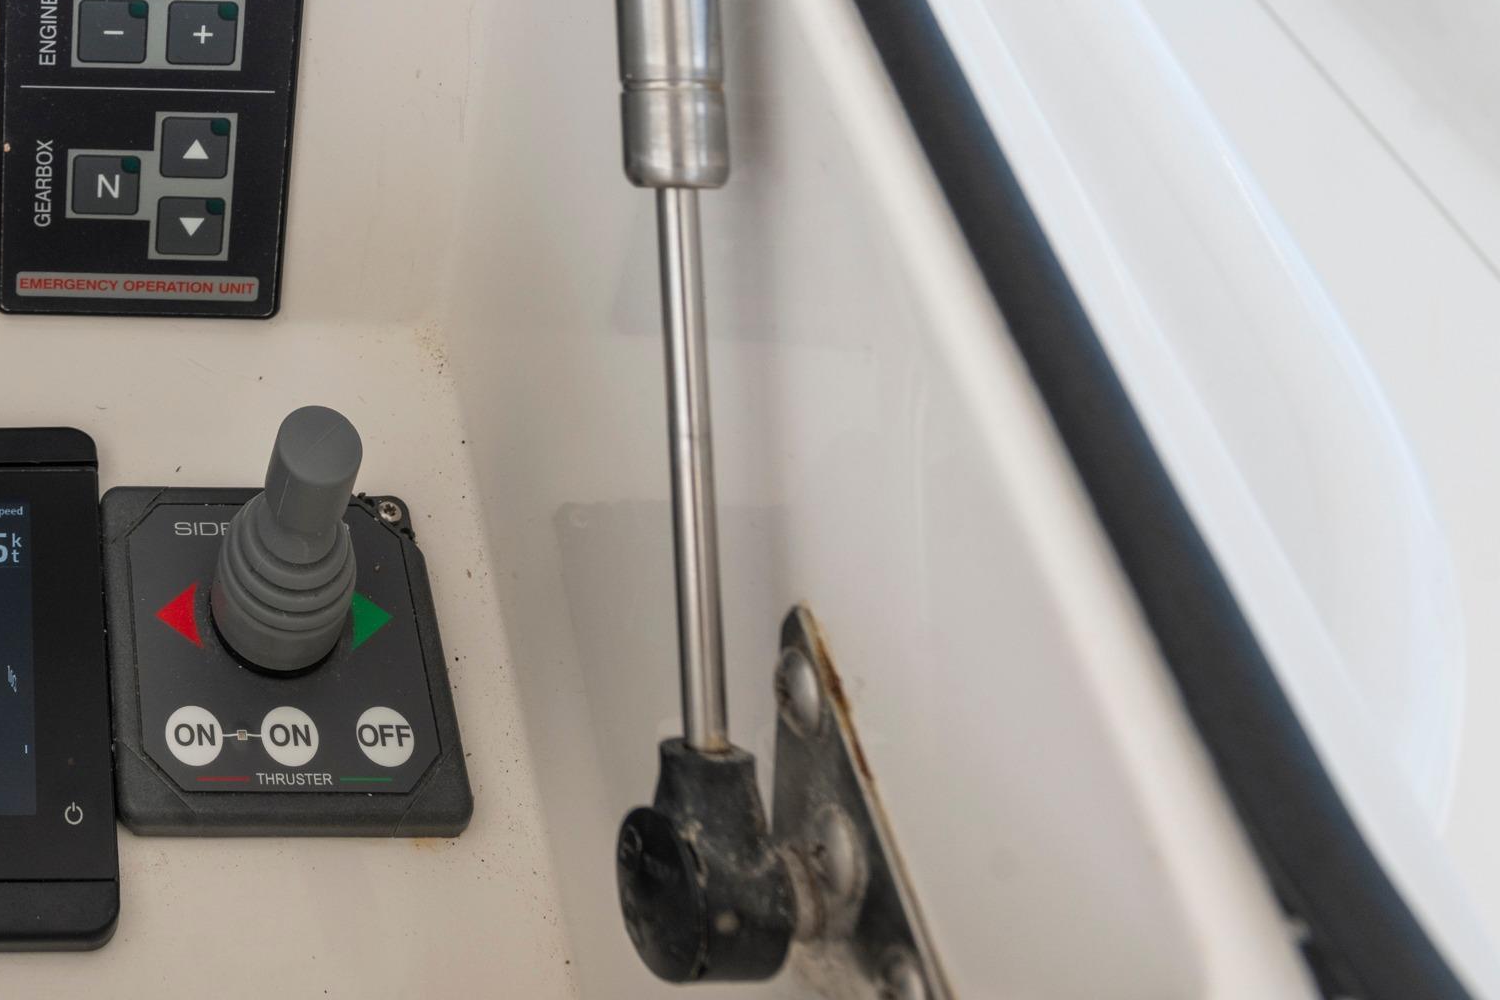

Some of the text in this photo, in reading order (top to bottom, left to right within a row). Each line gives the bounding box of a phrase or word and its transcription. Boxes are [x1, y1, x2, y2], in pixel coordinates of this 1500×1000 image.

[33, 139, 53, 228] GEARBOX
[97, 173, 120, 199] N
[19, 277, 256, 295] EMERGENCY OPERATION UNIT
[173, 723, 217, 747] ON
[269, 723, 312, 747] ON
[357, 723, 411, 748] OFF
[256, 773, 334, 786] THRUSTER
